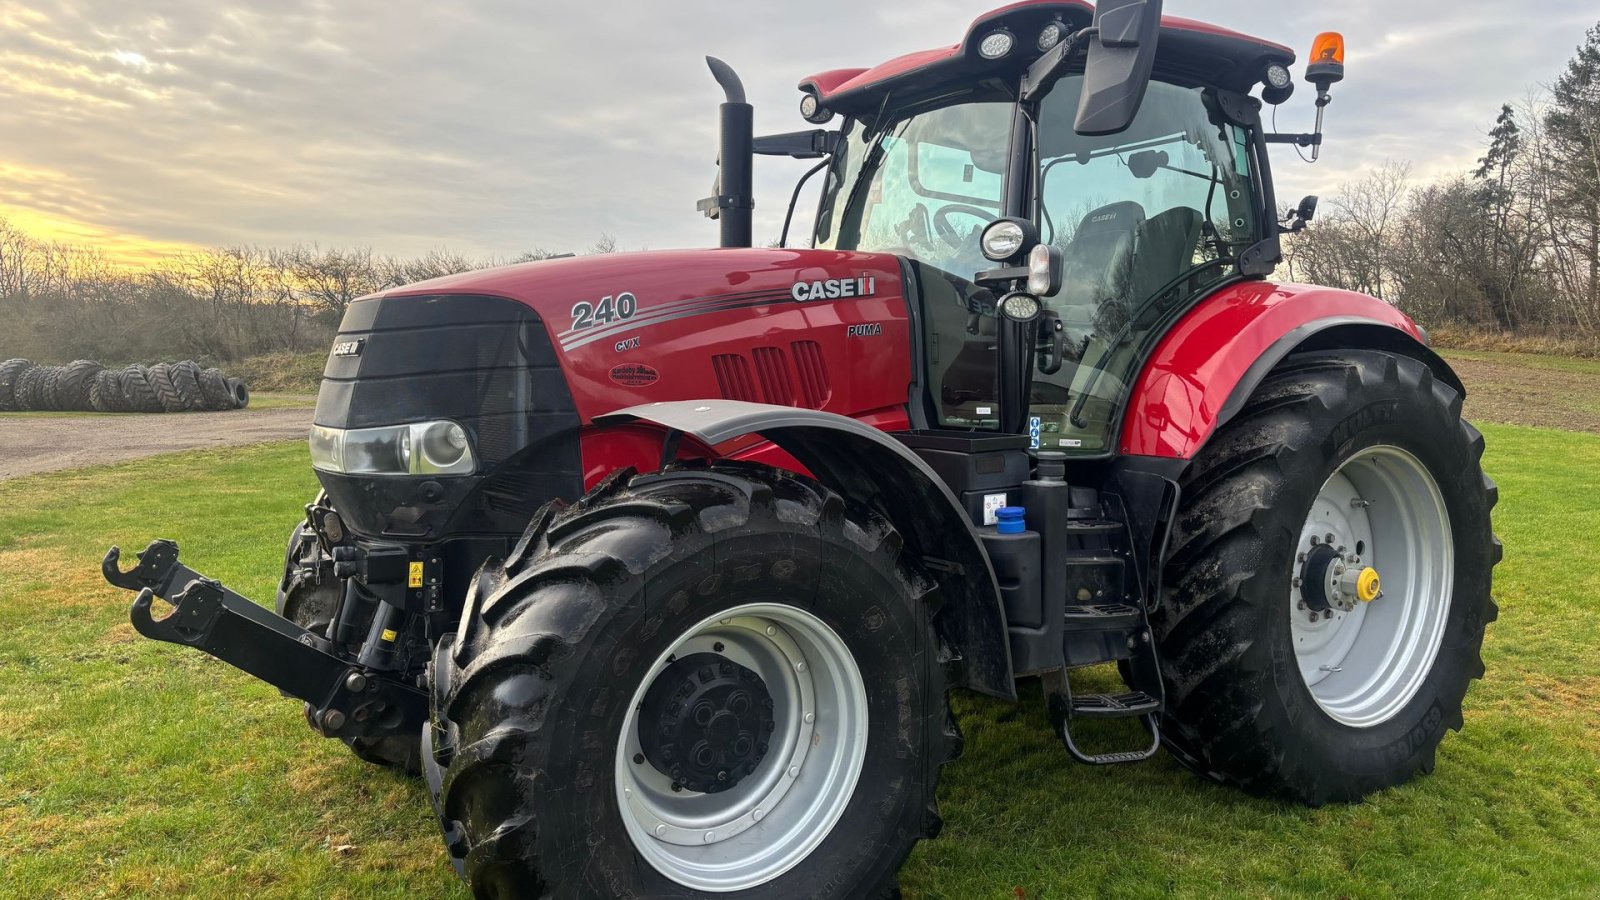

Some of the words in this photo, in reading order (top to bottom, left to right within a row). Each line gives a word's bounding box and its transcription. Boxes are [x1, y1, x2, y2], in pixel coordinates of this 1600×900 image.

[791, 278, 854, 301] CASE
[571, 292, 637, 332] 240
[847, 322, 882, 337] PUMA
[615, 336, 640, 353] CVX
